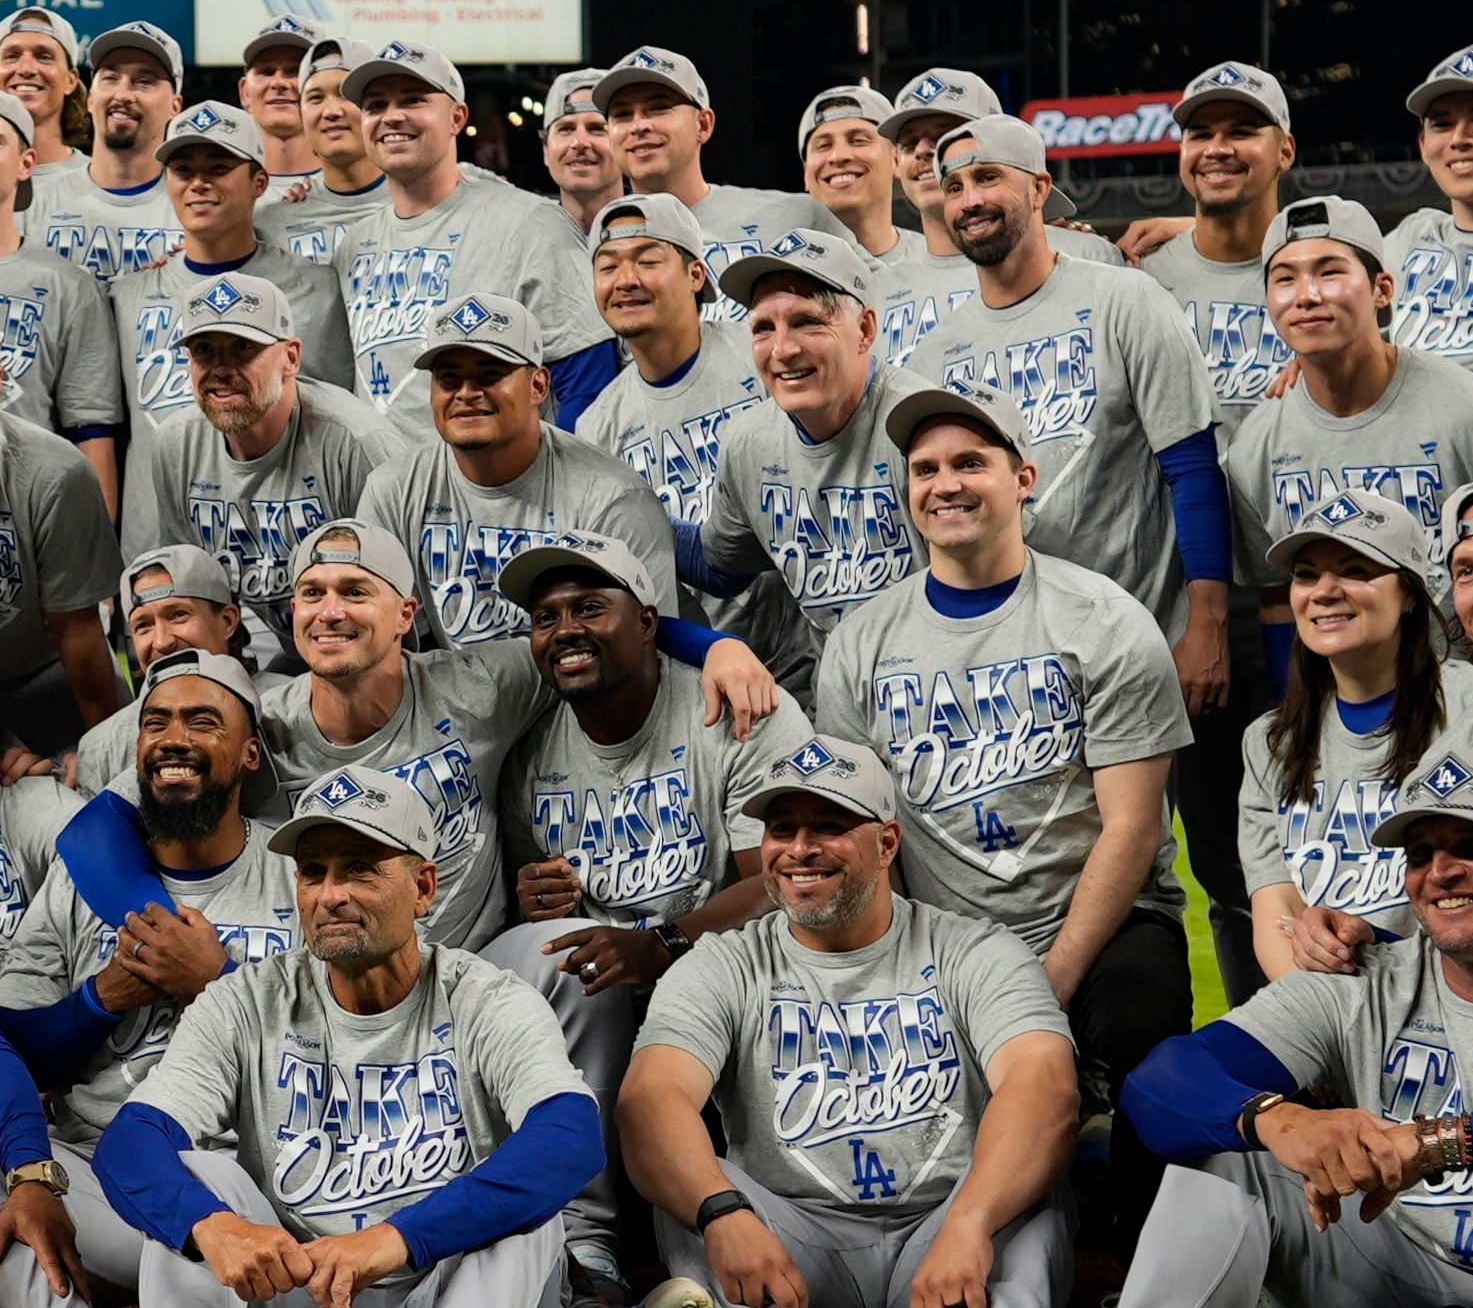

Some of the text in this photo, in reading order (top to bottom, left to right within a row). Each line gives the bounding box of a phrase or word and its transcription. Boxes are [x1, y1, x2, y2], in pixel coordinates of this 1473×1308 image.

[352, 6, 544, 23] Plumbing Electrical
[916, 77, 939, 101] LA
[193, 107, 215, 130] LA
[212, 282, 235, 309] LA
[460, 303, 483, 328] LA
[369, 350, 390, 395] LA
[190, 499, 327, 562] TAKE
[760, 482, 912, 556] TAKE
[1329, 500, 1353, 523] LA
[776, 527, 912, 600] October
[876, 652, 1086, 751] TAKE
[800, 745, 820, 769] LA
[899, 710, 1081, 805] October
[1435, 766, 1458, 792] LA
[326, 778, 348, 803] LA
[534, 768, 704, 859] TAKE
[973, 801, 1016, 853] LA
[768, 986, 959, 1083] TAKE
[279, 1049, 466, 1148] TAKE
[774, 1047, 961, 1141] October
[273, 1115, 469, 1208] October
[849, 1139, 897, 1200] LA
